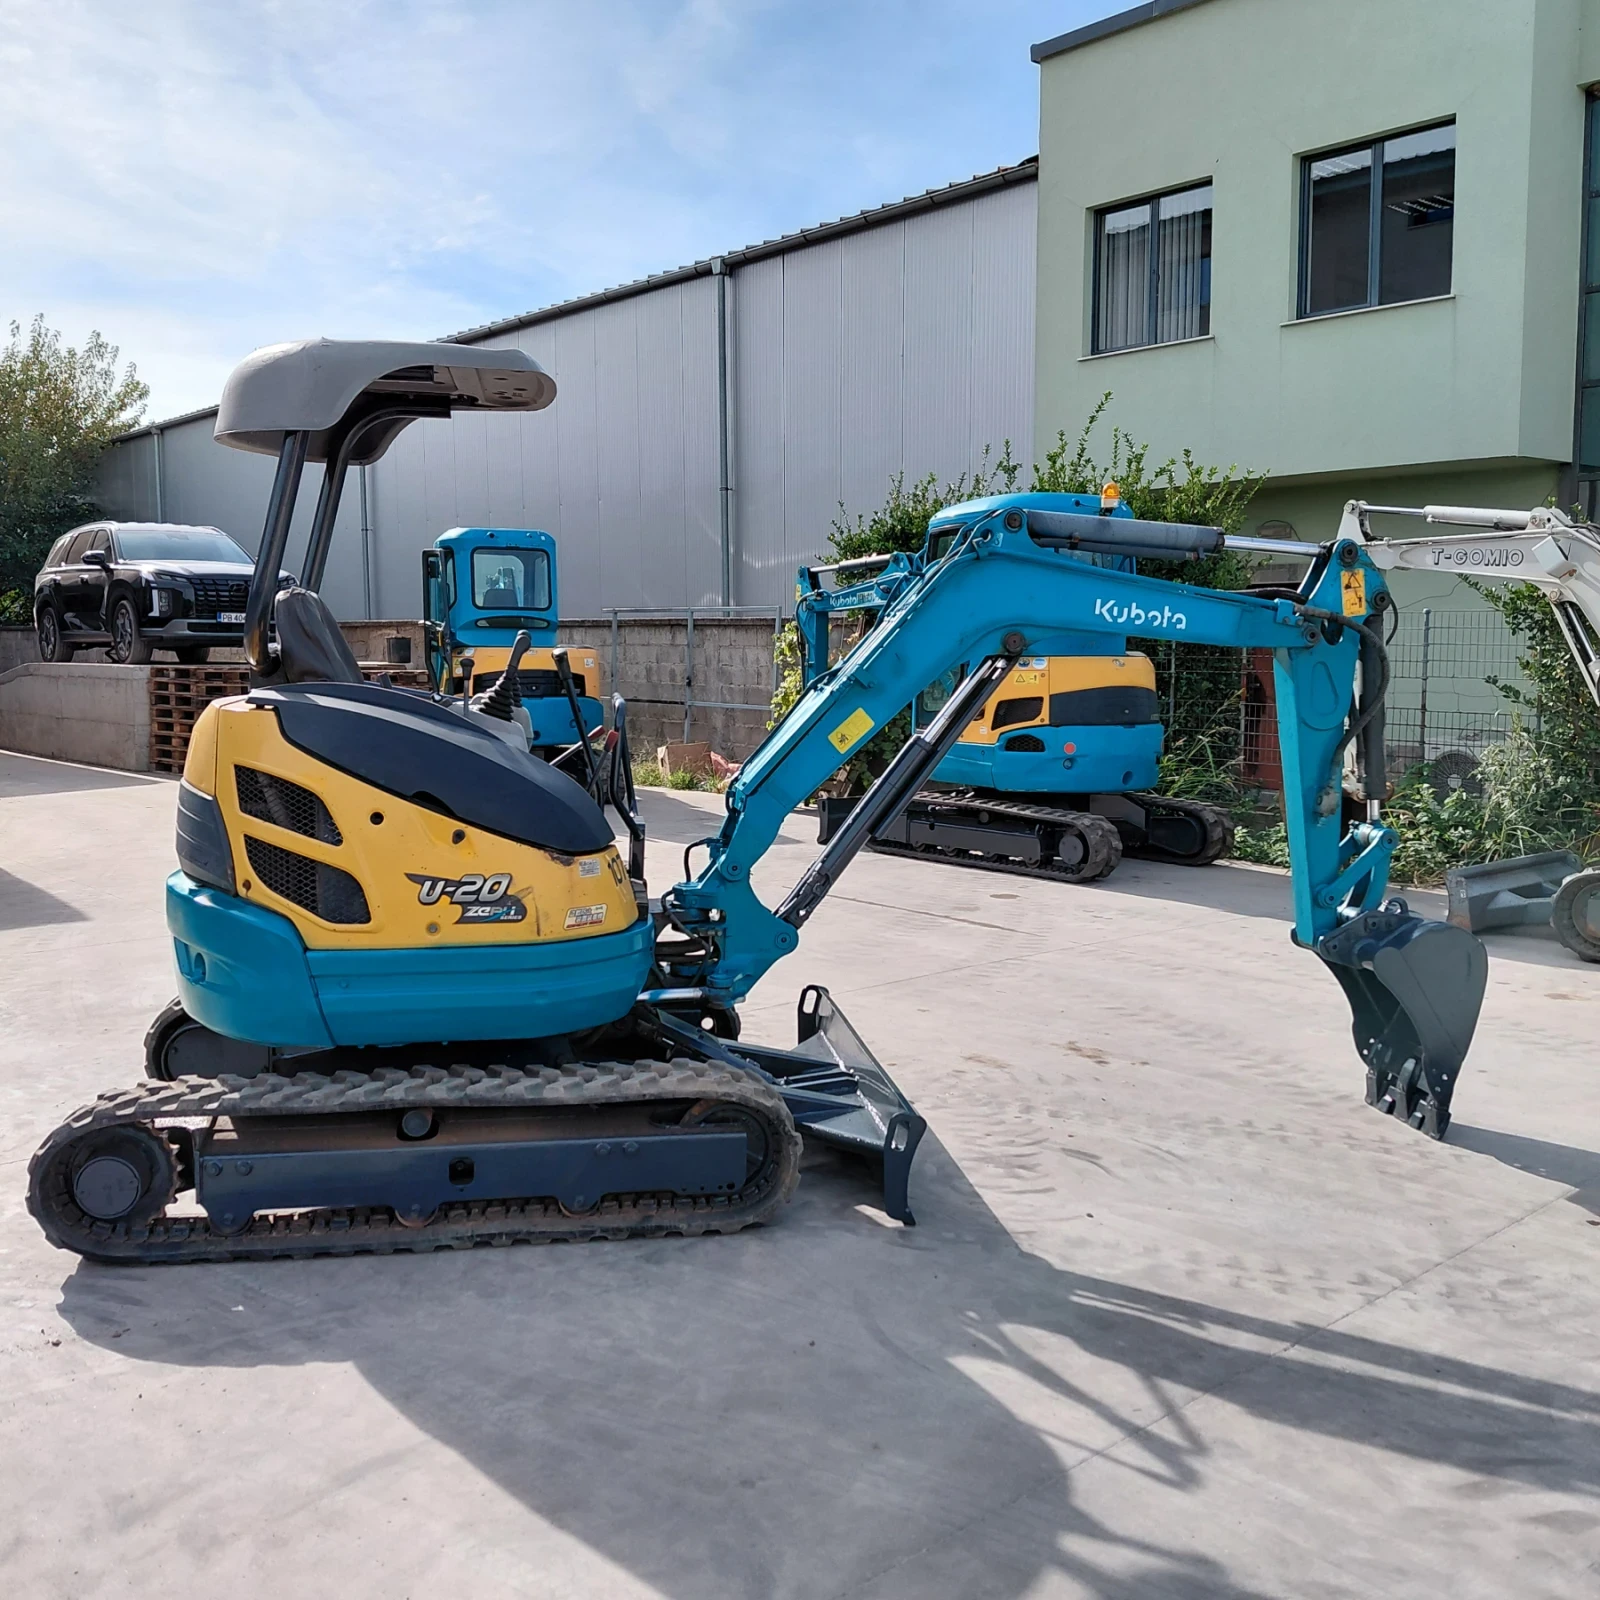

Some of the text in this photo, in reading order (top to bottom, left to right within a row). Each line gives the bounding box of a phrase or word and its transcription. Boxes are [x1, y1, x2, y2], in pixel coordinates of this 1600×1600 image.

[1432, 548, 1524, 566] T-GOMIO
[829, 595, 858, 607] Kubota
[1095, 599, 1187, 630] Kubota
[419, 873, 511, 904] U-20
